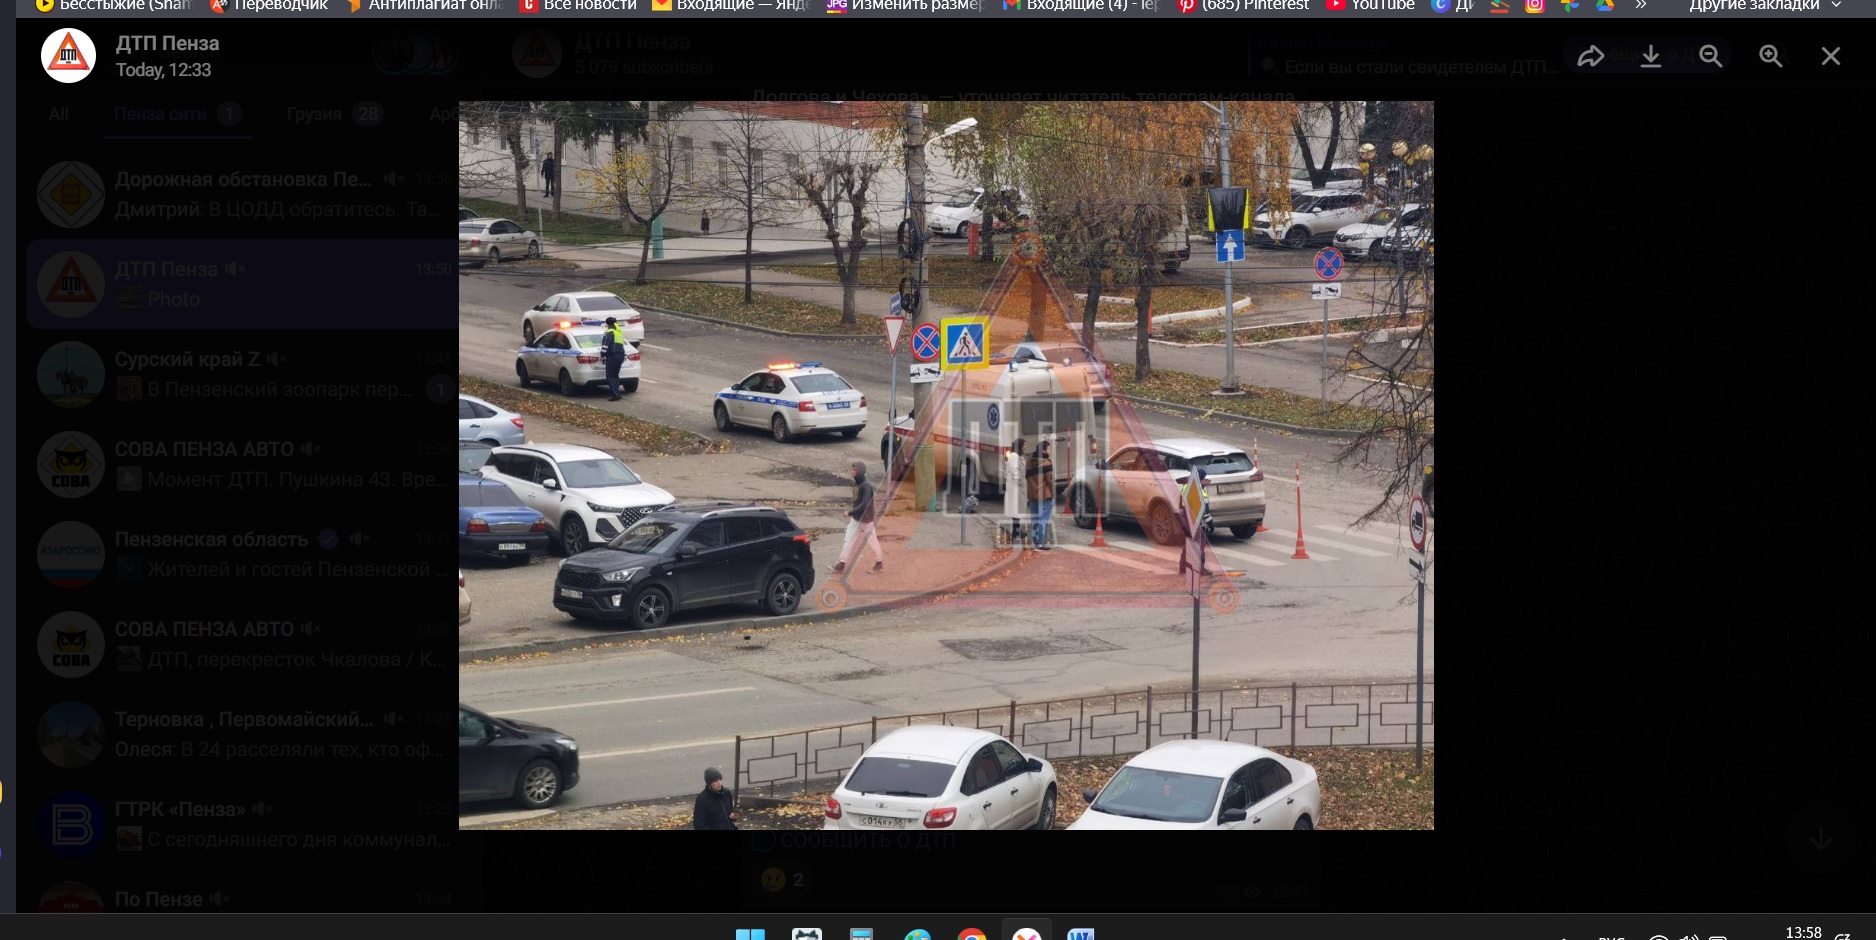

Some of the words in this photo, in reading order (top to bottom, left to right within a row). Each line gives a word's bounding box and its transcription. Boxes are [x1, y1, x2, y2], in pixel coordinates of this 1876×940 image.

[236, 0, 328, 12] Переводчик
[369, 0, 467, 9] Антиплагиат
[545, 0, 571, 9] Все
[576, 0, 636, 9] новости
[678, 0, 754, 11] Входящие
[853, 0, 928, 9] Изменить
[1028, 0, 1104, 11] Входящие
[1203, 0, 1240, 11] (685)
[1245, 0, 1309, 9] Pinterest
[1353, 0, 1415, 9] YouTube
[1690, 0, 1746, 12] Другие
[1750, 0, 1819, 11] закладки
[116, 35, 156, 54] ДТП
[163, 35, 219, 51] Пенза
[575, 32, 621, 53] ДТП
[627, 32, 691, 50] Пенза
[59, 48, 78, 61] ДТП
[116, 62, 165, 80] Today,
[169, 63, 211, 77] 12:33
[623, 59, 713, 73] subscribers
[1286, 60, 1323, 73] Если
[1329, 63, 1351, 73] вы
[1357, 63, 1403, 74] стали
[1408, 63, 1506, 76] свидетелем
[49, 106, 68, 120] All
[115, 107, 164, 120] Пенза
[169, 110, 206, 120] сити
[226, 107, 231, 120] 1
[288, 107, 341, 124] Грузия
[359, 107, 377, 120] 28
[115, 171, 212, 190] Дорожная
[219, 170, 327, 187] обстановка
[115, 201, 204, 220] Дмитрий:
[210, 202, 220, 216] В
[228, 201, 284, 220] ЦОДД
[290, 201, 399, 220] обратитесь.
[115, 261, 155, 280] ДТП
[162, 261, 217, 277] Пенза
[416, 263, 451, 277] 13:50
[61, 276, 81, 291] ДТП
[149, 291, 200, 307] Photo
[116, 351, 192, 370] Сурский
[199, 351, 242, 370] край
[248, 352, 260, 366] Z
[149, 381, 159, 396] В
[166, 381, 277, 397] Пензенский
[283, 385, 360, 400] зоопарк
[115, 441, 168, 456] СОВА
[174, 441, 238, 456] ПЕНЗА
[243, 441, 294, 456] АВТО
[51, 474, 91, 489] СОВА
[149, 472, 223, 487] Момент
[228, 472, 272, 490] ДТП.
[280, 472, 363, 491] Пушкина
[369, 471, 395, 486] 43.
[116, 531, 226, 547] Пензенская
[232, 530, 308, 547] область
[148, 560, 229, 576] Жителей
[236, 565, 245, 576] и
[253, 561, 311, 576] гостей
[318, 561, 429, 576] Пензенской
[115, 621, 168, 636] СОВА
[174, 621, 238, 636] ПЕНЗА
[243, 621, 294, 636] АВТО
[52, 654, 91, 667] СОВА
[148, 652, 192, 670] ДТП,
[198, 655, 315, 670] перекресток
[322, 652, 400, 667] Чкалова
[115, 711, 203, 730] Терновка
[116, 741, 176, 757] Олеся:
[182, 741, 192, 756] В
[199, 741, 221, 756] 24
[227, 745, 324, 760] расселяли
[330, 745, 362, 759] тех,
[369, 745, 399, 756] кто
[116, 801, 164, 816] ГТРК
[169, 801, 245, 816] «Пенза»
[148, 831, 160, 846] С
[166, 835, 297, 850] сегодняшнего
[303, 835, 336, 850] дня
[782, 830, 891, 850] СООБЩИТЬ
[916, 830, 955, 850] ДТП
[794, 873, 803, 886] 2
[116, 891, 140, 907] По
[146, 891, 203, 907] Пензе
[1787, 927, 1822, 938] 13:58
